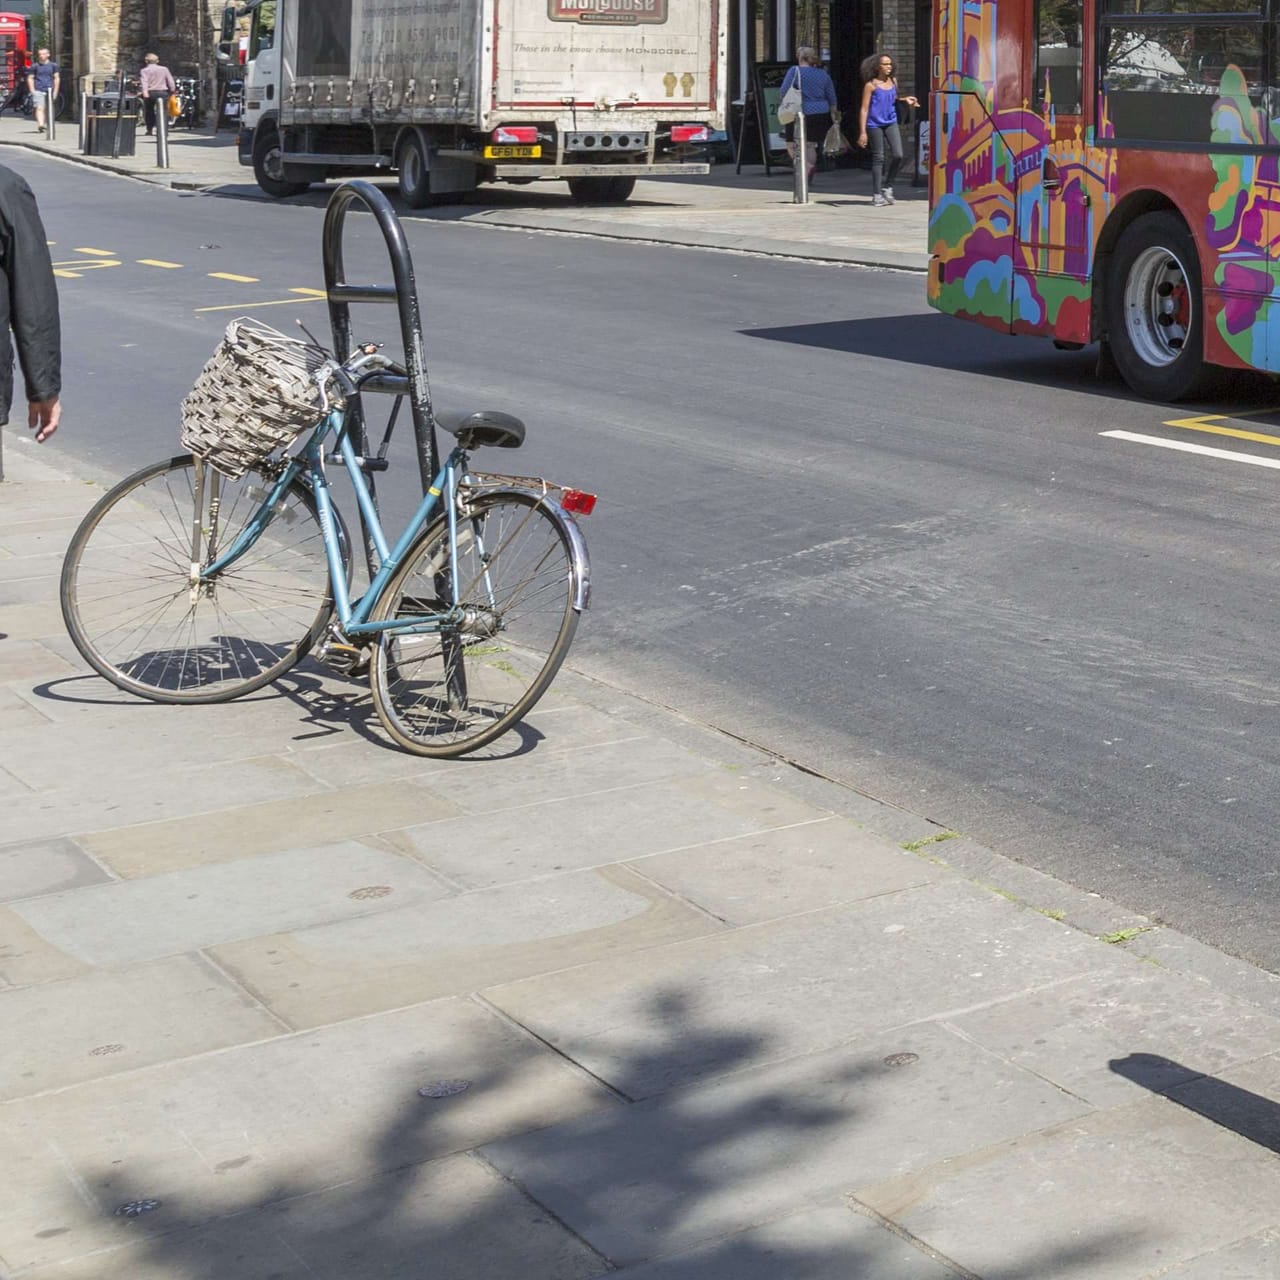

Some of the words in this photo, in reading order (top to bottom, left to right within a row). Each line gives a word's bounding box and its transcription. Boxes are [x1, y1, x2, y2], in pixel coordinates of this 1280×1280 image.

[514, 43, 539, 53] Those
[540, 44, 550, 53] in
[553, 44, 568, 53] the
[570, 45, 592, 54] know
[595, 45, 623, 54] choose
